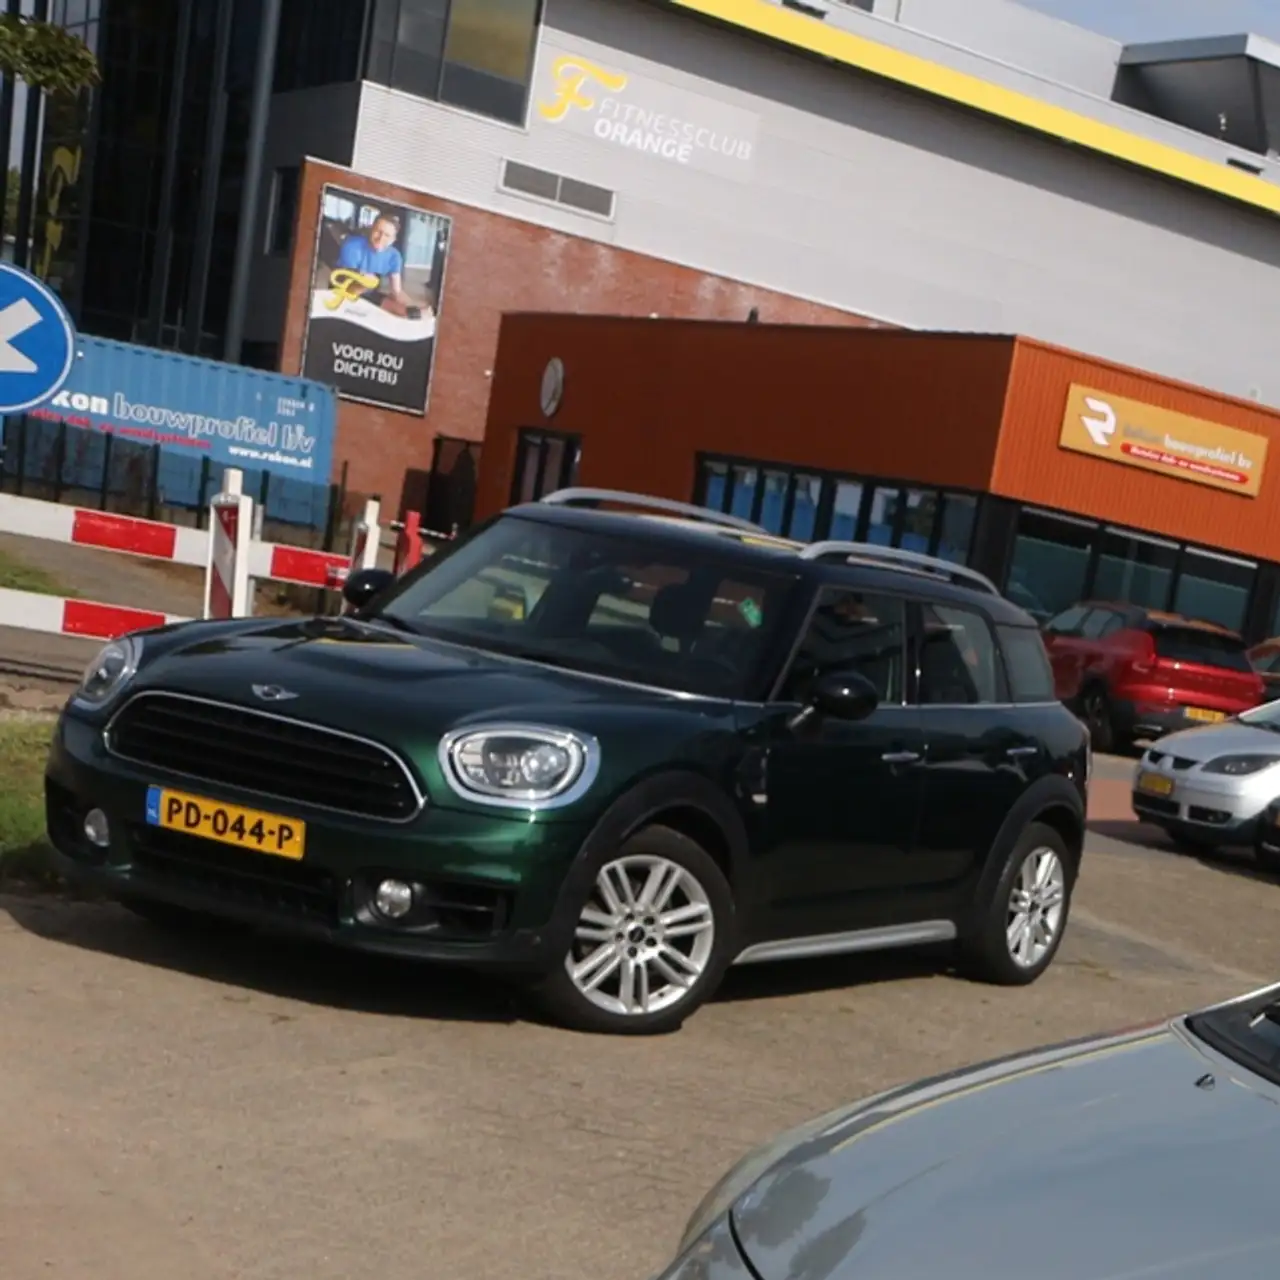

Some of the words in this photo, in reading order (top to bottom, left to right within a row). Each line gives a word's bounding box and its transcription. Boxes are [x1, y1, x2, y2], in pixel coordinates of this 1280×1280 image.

[593, 117, 694, 164] ORANGE
[598, 97, 753, 161] FITNESSCLUB
[331, 341, 375, 364] VOOR
[375, 352, 405, 371] JOU
[333, 358, 399, 387] DICHTBIJ
[113, 391, 279, 448] bouwprofiel
[167, 797, 294, 850] PD-044-P
